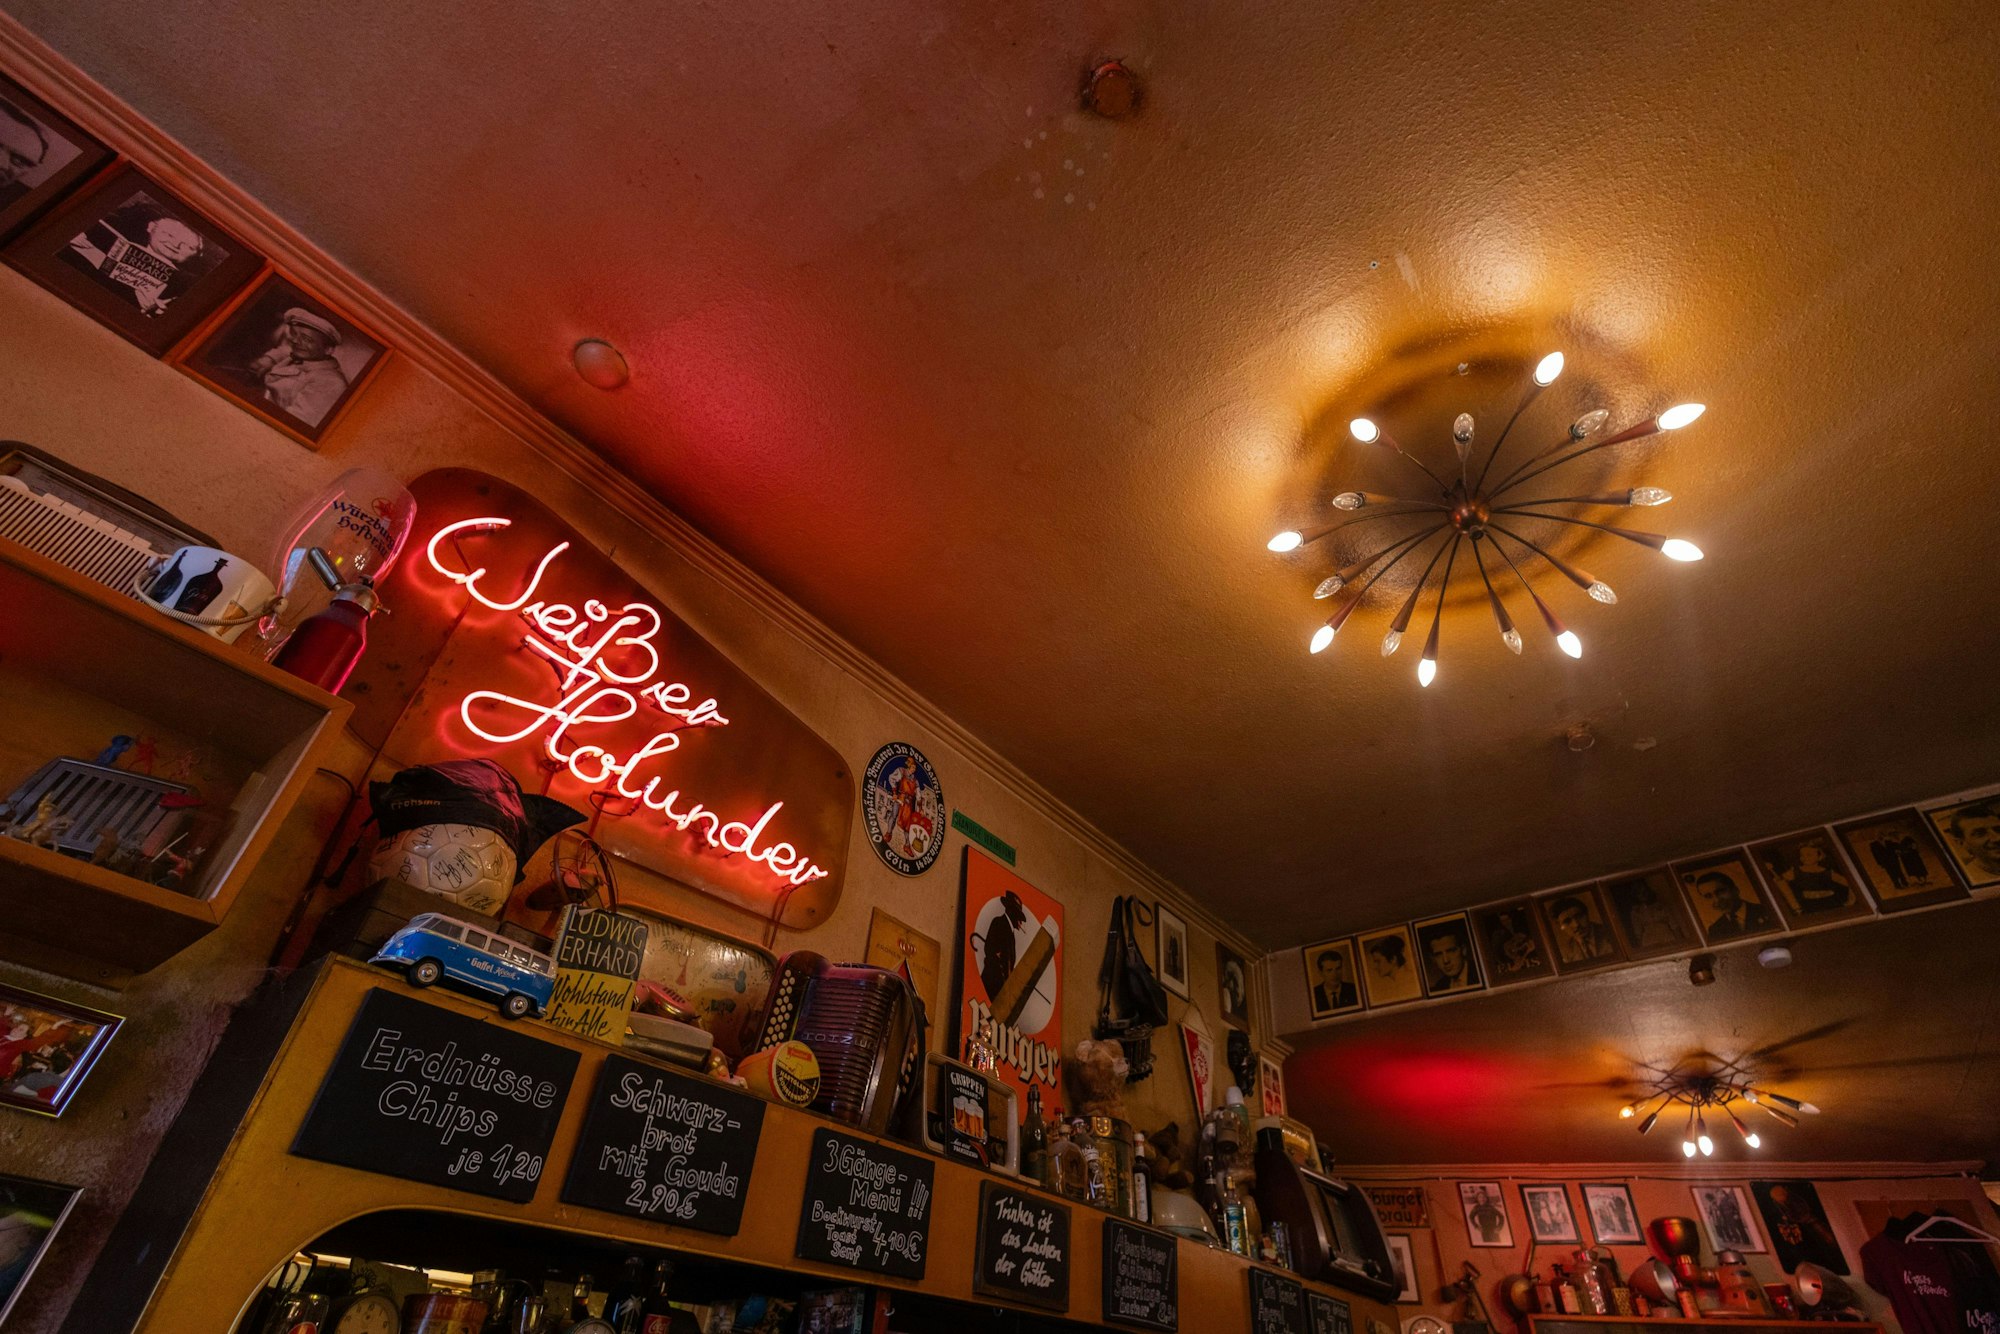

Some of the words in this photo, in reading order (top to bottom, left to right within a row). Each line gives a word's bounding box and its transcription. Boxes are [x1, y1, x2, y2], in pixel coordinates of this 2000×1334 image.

[121, 254, 169, 281] ERHARD
[127, 247, 174, 276] LUDWIG
[427, 517, 728, 725] Weißer
[460, 635, 828, 885] Holunder
[867, 744, 895, 778] Brauerei
[885, 848, 910, 873] Cöln
[568, 911, 645, 950] LUDWIG
[469, 956, 494, 974] Gaffel
[560, 936, 640, 977] ERHARD
[552, 973, 628, 1009] Wohlstand
[361, 1027, 557, 1109] Erdnüsse
[378, 1080, 498, 1145] Chips
[610, 1072, 741, 1133] Schwarz-
[640, 1115, 698, 1155] brot
[447, 1147, 483, 1175] je
[490, 1143, 542, 1185] 1,20
[599, 1144, 649, 1178] mit
[664, 1155, 739, 1198] Gouda
[625, 1179, 700, 1219] 2,90€
[850, 1178, 902, 1213] Menü
[1369, 1189, 1422, 1209] burger
[812, 1199, 877, 1233] Bockwurst
[995, 1196, 1035, 1228] Trinken
[1037, 1209, 1054, 1234] ist
[824, 1223, 857, 1245] Toast
[1000, 1227, 1021, 1249] das
[1021, 1231, 1061, 1262] Lachen
[830, 1241, 863, 1266] Senf
[994, 1252, 1017, 1277] der
[1020, 1257, 1055, 1288] Götter
